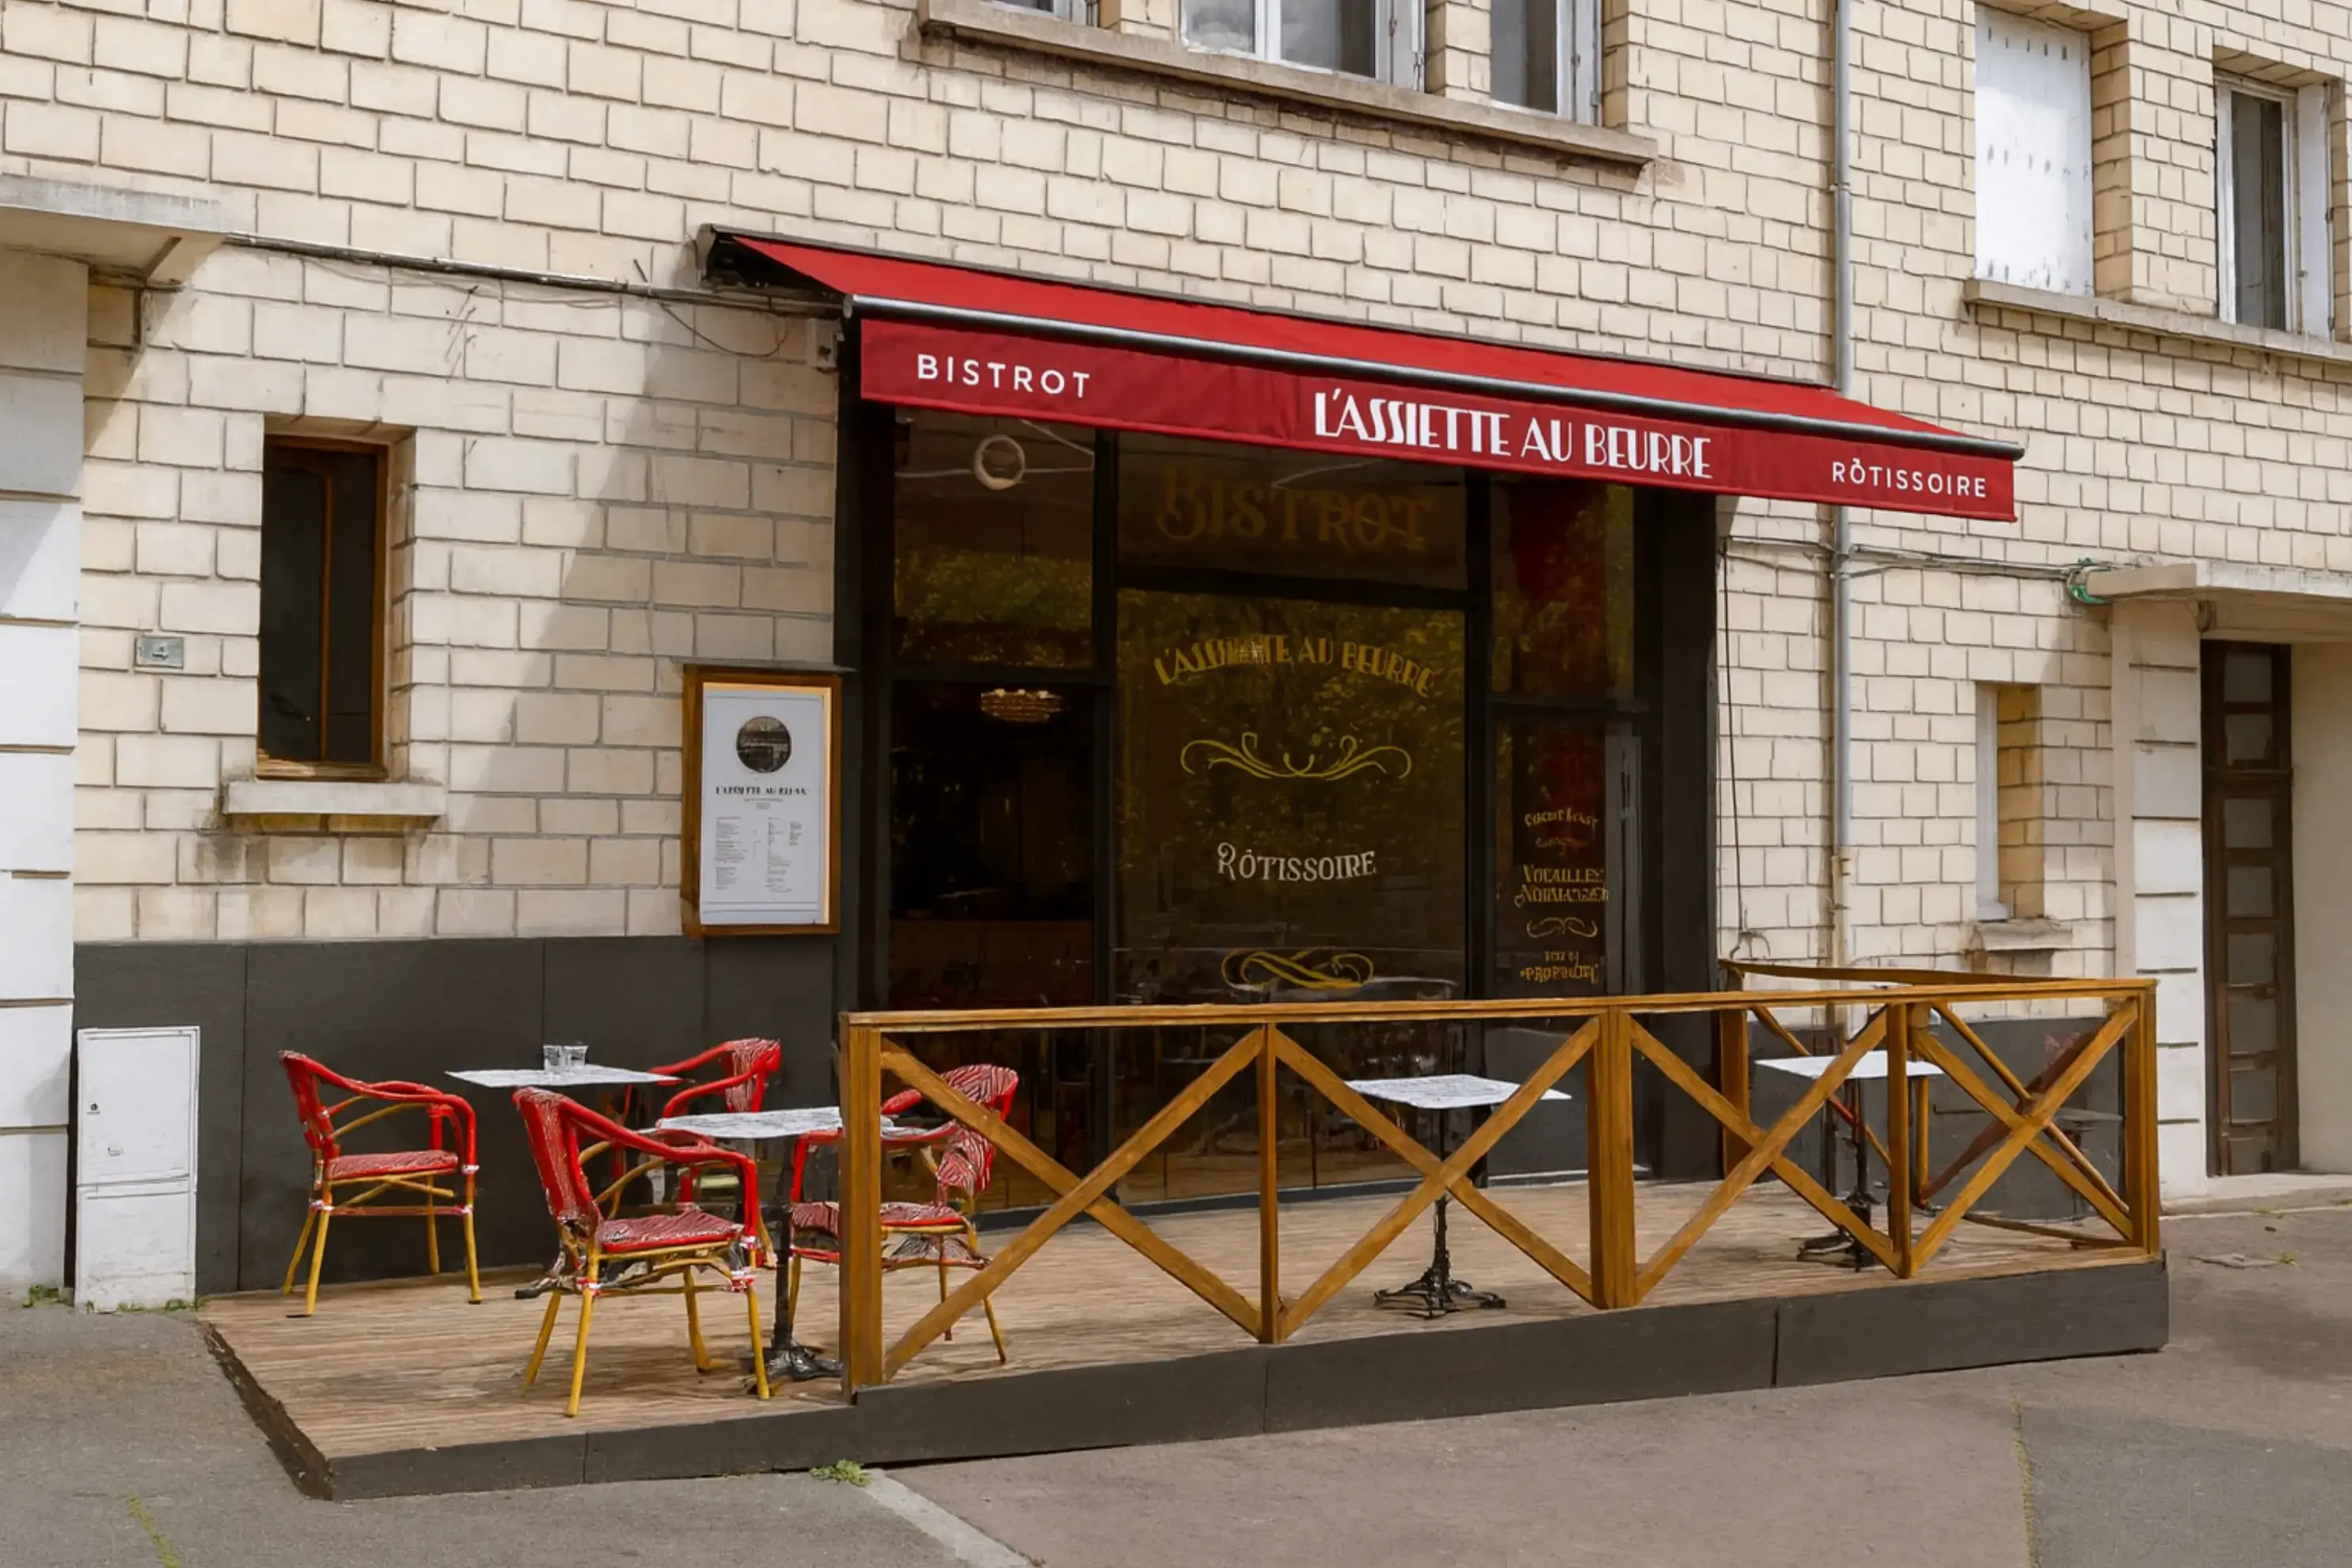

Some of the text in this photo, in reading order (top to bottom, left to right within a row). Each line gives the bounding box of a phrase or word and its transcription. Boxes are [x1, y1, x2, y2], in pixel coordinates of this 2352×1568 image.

[917, 353, 1090, 398] BISTROT
[1314, 387, 1713, 479] L'ASSIETTE AU BEURRE
[1155, 463, 1437, 554] BISTROT
[1832, 457, 1987, 499] RÔTISSOIRE
